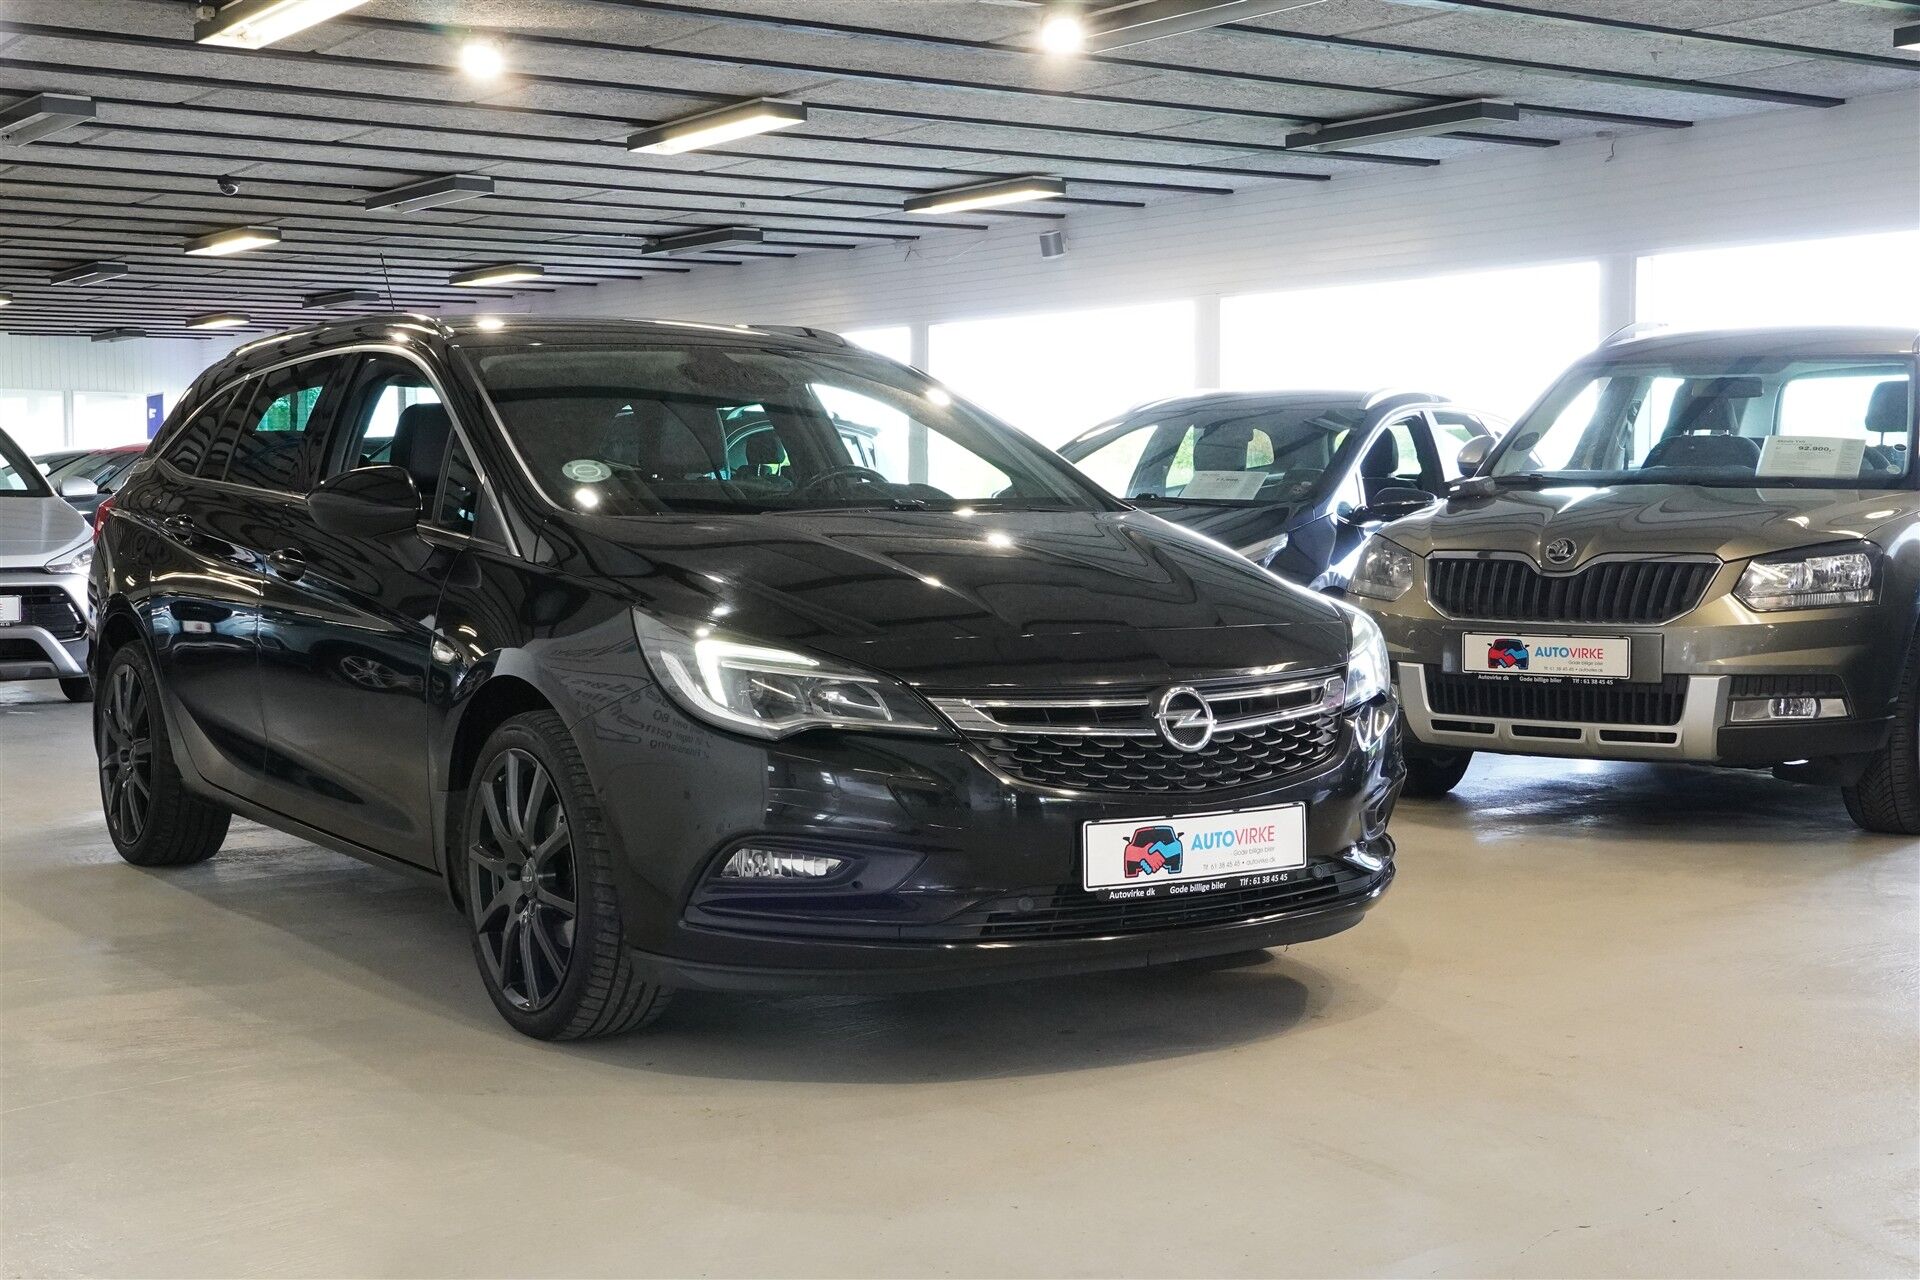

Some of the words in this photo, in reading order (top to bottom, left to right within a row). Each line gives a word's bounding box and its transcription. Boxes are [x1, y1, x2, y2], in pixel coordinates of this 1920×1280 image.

[1534, 646, 1604, 660] AUTOVIRKE
[1191, 825, 1275, 851] AUTOVIRKE
[1109, 888, 1145, 900] Autovirke
[1146, 888, 1155, 896] dk
[1170, 885, 1188, 894] Gode
[1189, 883, 1210, 893] billige
[1211, 881, 1227, 890] biler
[1252, 876, 1261, 885] 61
[1262, 875, 1270, 884] 38
[1270, 874, 1279, 883] 45
[1279, 873, 1288, 882] 45
